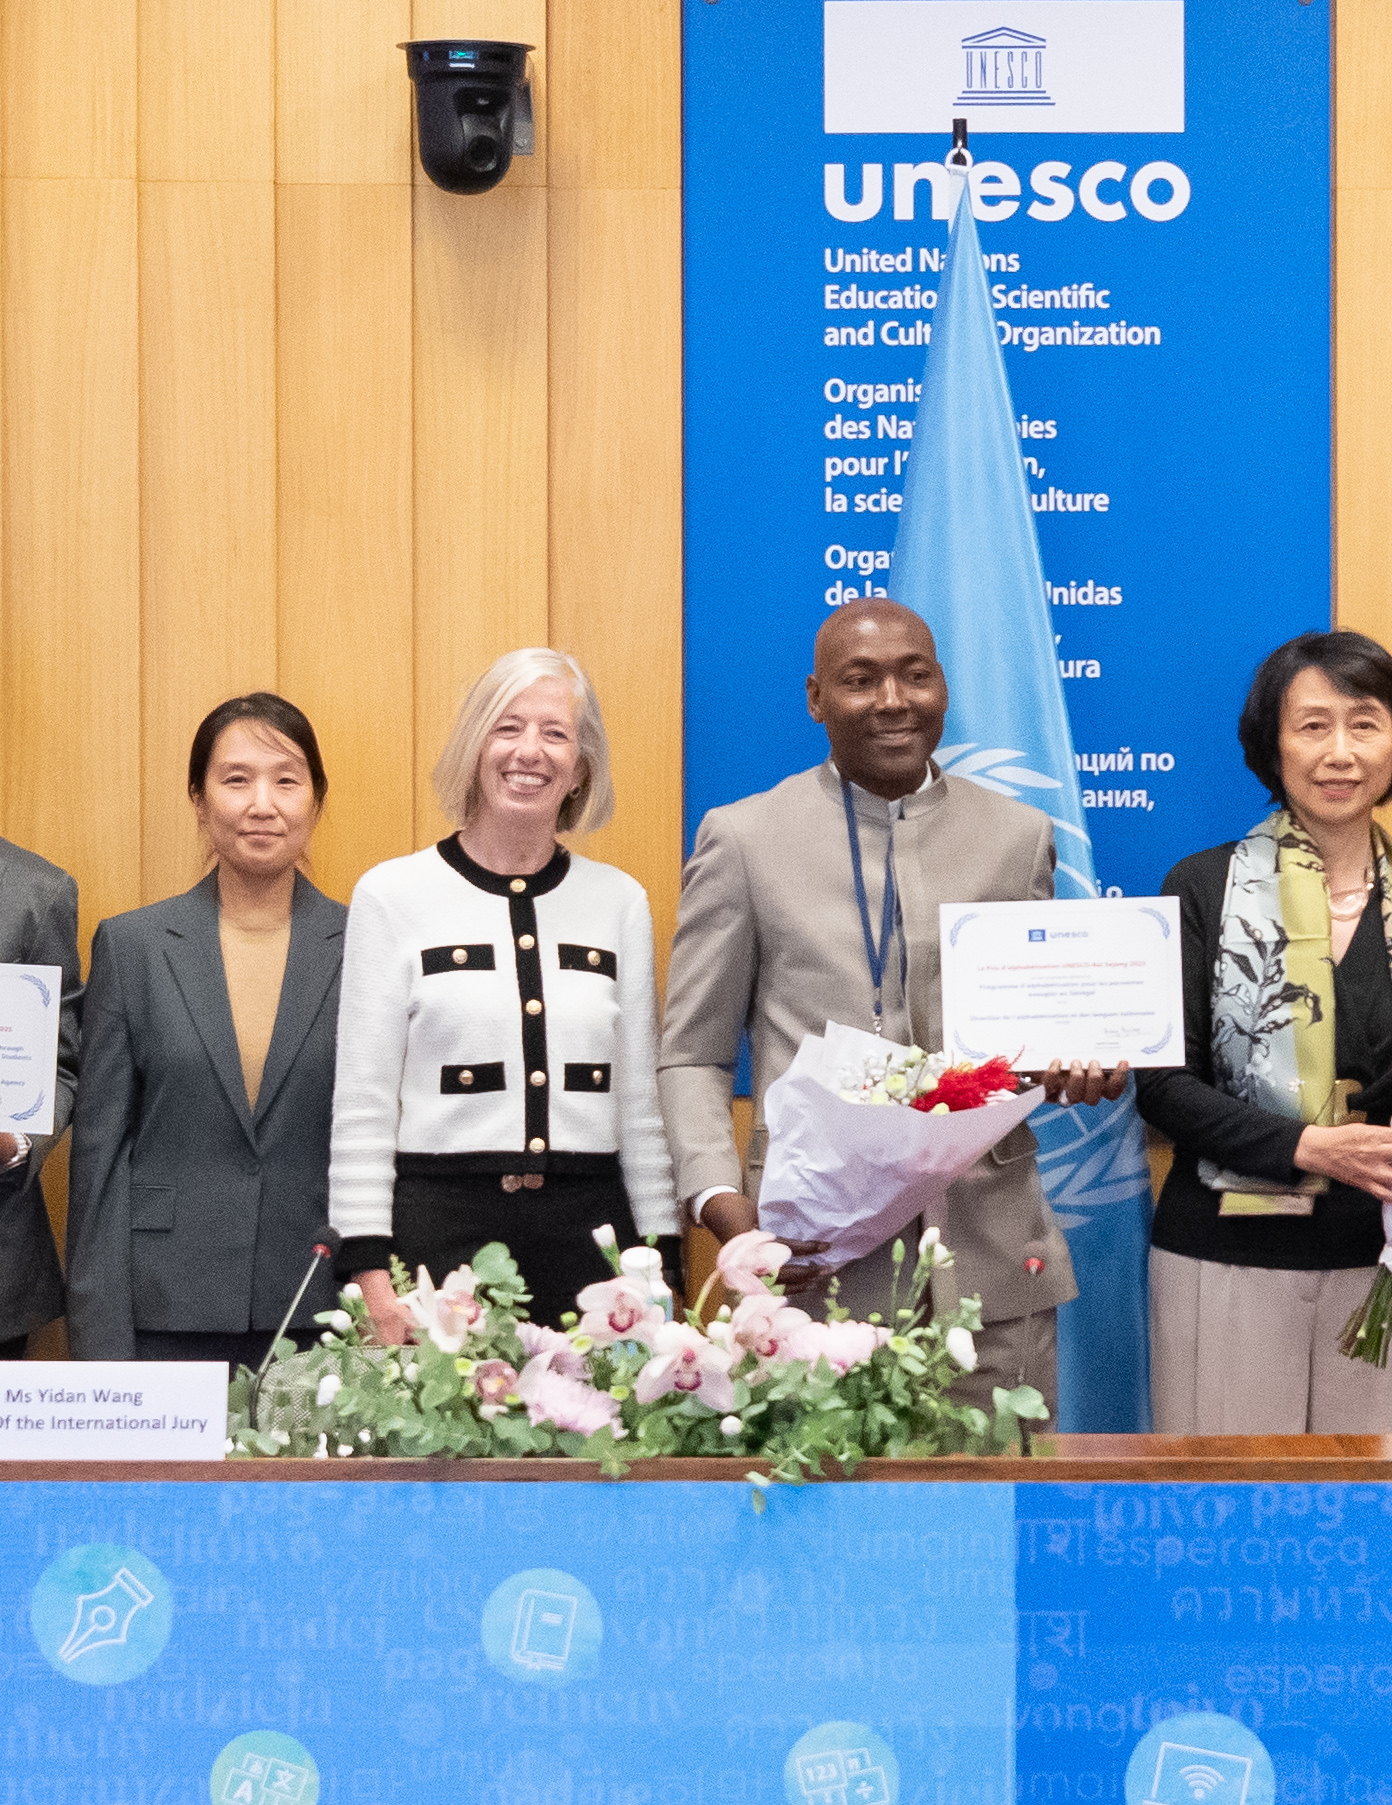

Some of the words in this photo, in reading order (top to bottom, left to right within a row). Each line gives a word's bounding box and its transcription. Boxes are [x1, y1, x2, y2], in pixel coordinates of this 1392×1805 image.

[966, 51, 1043, 89] UNESCO
[823, 160, 1191, 222] unesco
[824, 247, 912, 273] United
[824, 283, 938, 309] Educatio
[992, 283, 1110, 309] Scientific
[824, 320, 874, 346] and
[880, 321, 932, 346] Cult
[824, 414, 871, 439] des
[825, 456, 889, 482] pour
[825, 487, 848, 512] la
[854, 488, 903, 512] scie
[1031, 487, 1110, 512] ulture
[825, 580, 858, 605] de
[1140, 753, 1175, 772] по
[6, 1389, 33, 1404] Ms
[37, 1389, 86, 1404] Yidan
[93, 1389, 144, 1406] Wang
[16, 1415, 45, 1430] the
[51, 1415, 167, 1430] International
[171, 1415, 208, 1433] Jury
[805, 1763, 838, 1782] 123
